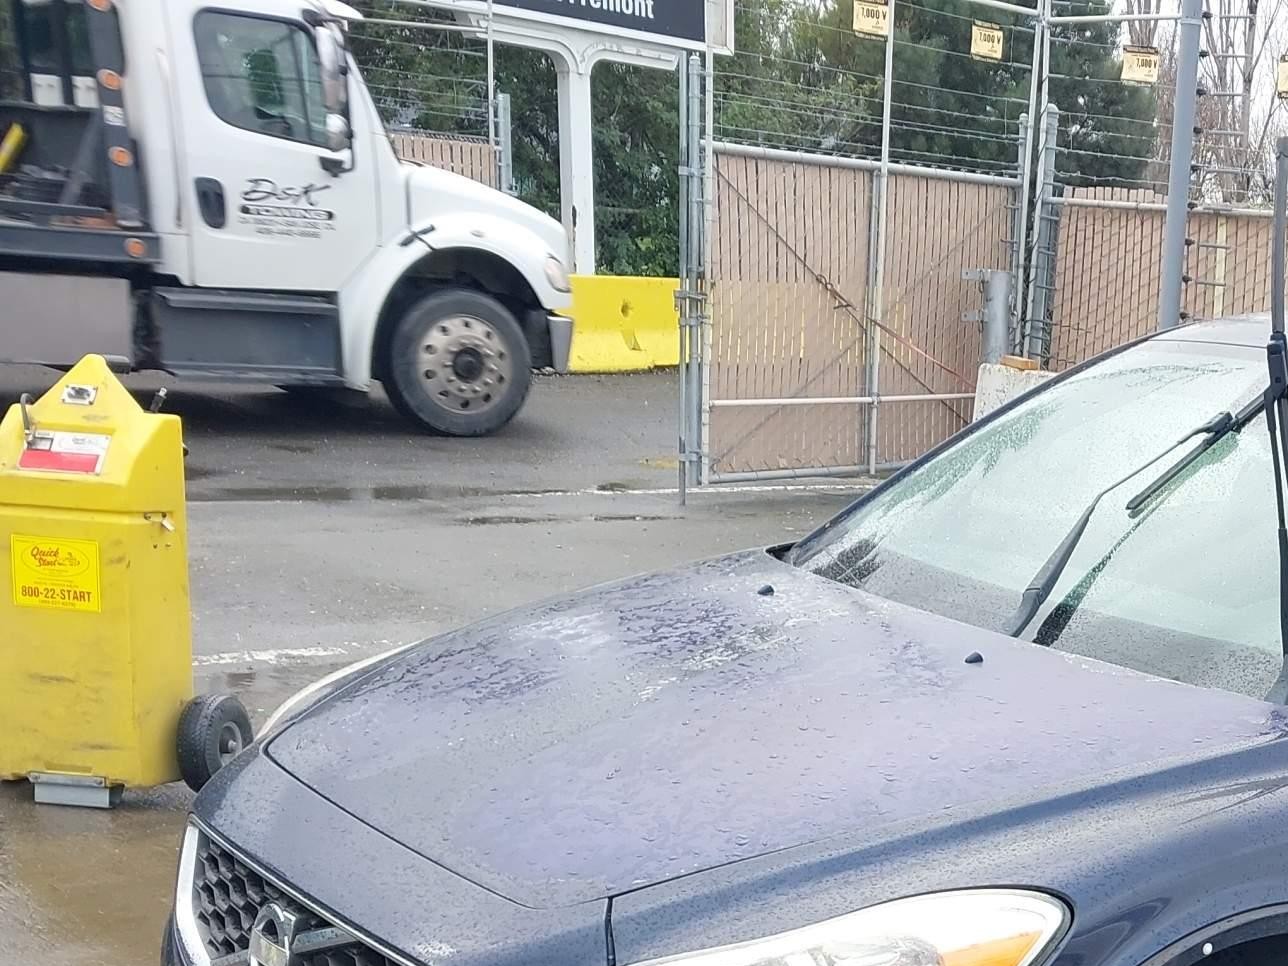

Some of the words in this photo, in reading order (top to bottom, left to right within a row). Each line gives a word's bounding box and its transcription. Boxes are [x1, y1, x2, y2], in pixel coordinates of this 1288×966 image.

[568, 0, 655, 19] emont
[30, 545, 60, 560] Quick
[21, 584, 93, 604] 800-22-START
